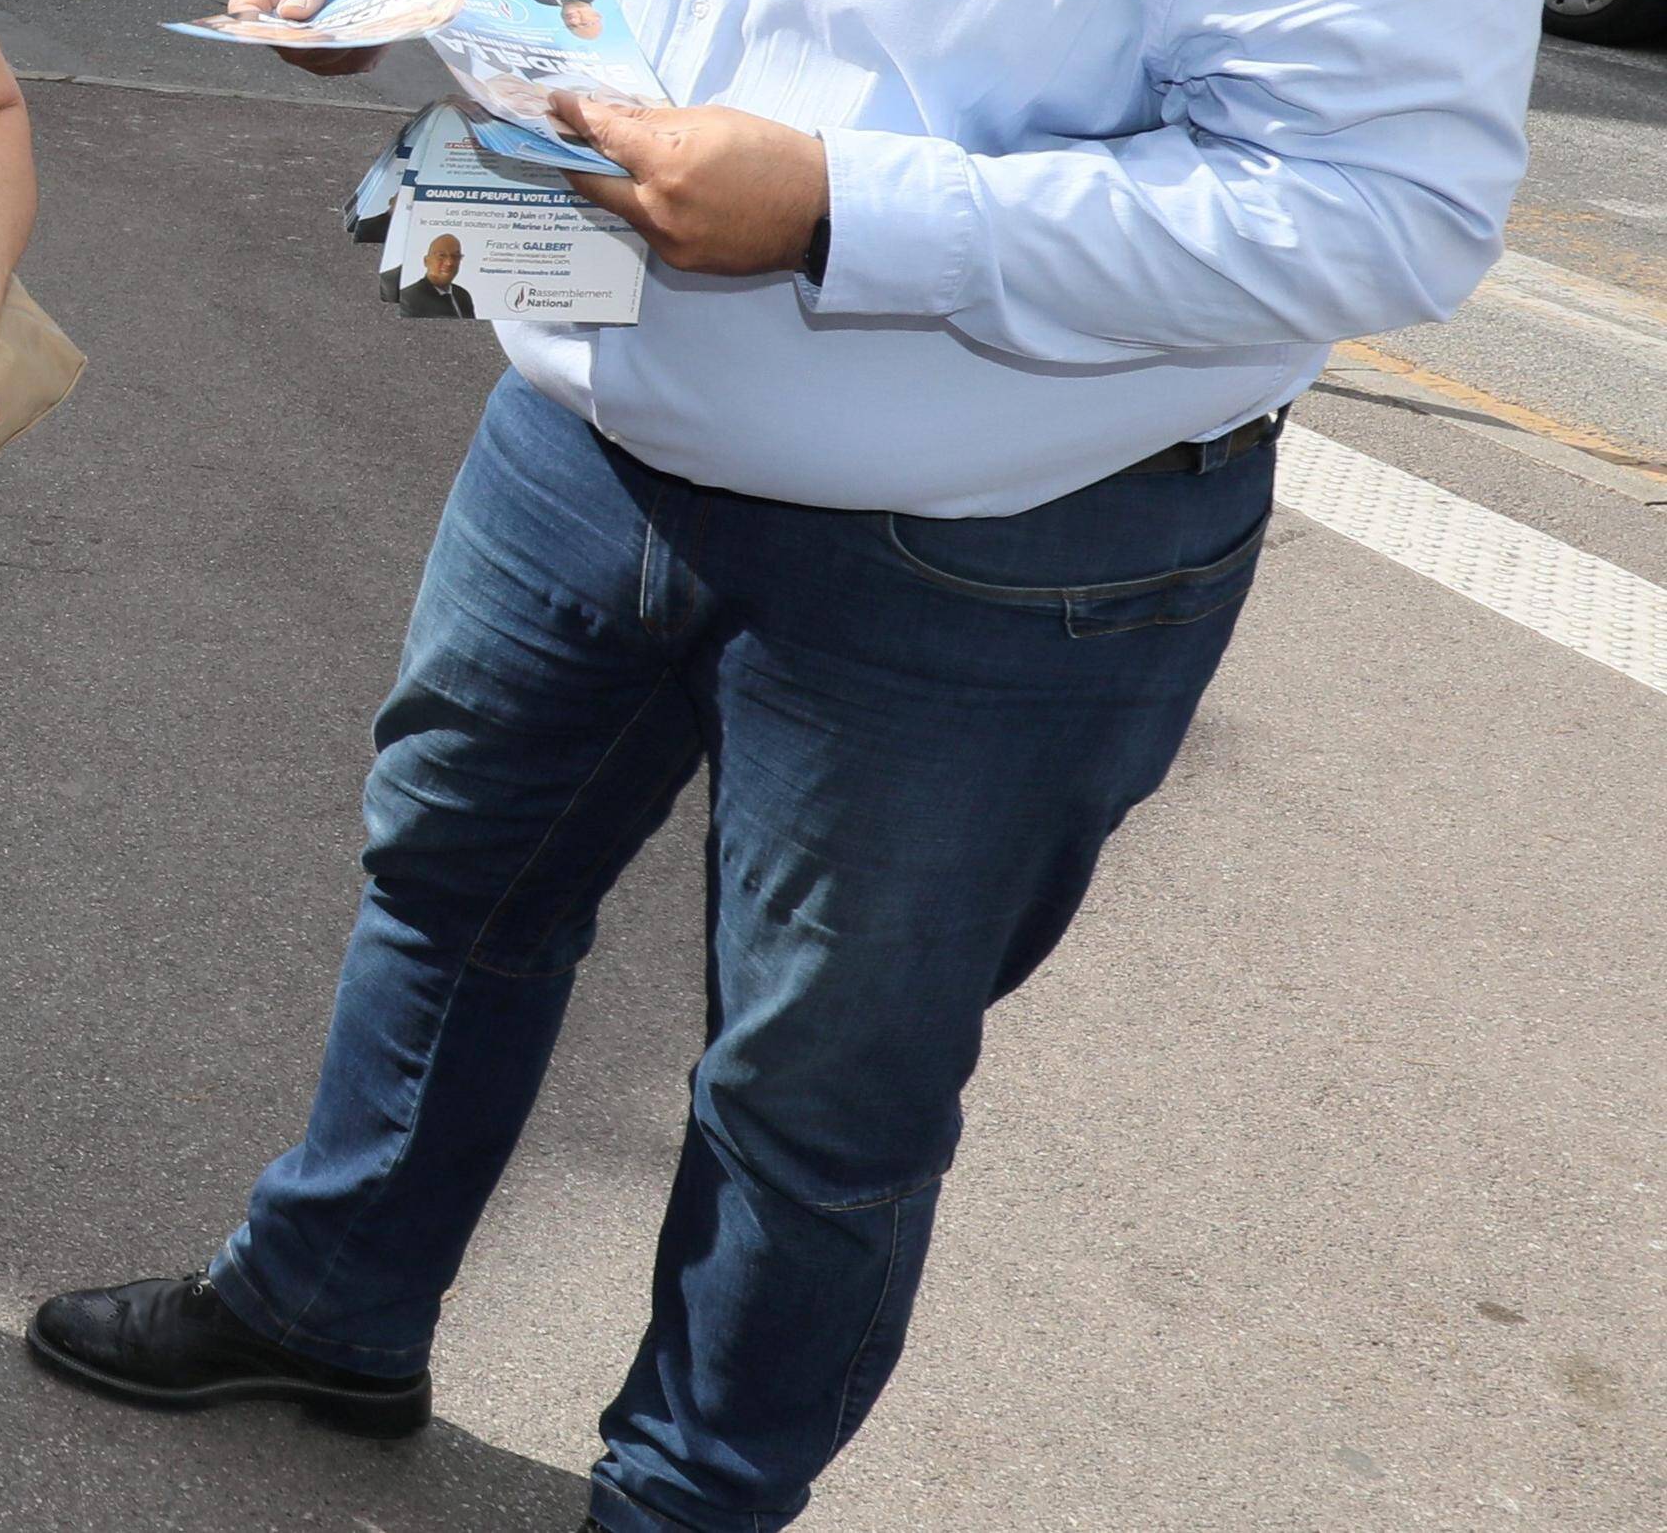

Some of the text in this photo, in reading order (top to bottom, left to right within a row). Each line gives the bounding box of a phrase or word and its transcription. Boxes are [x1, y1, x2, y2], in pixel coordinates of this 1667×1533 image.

[426, 189, 465, 199] QUAND
[466, 191, 479, 199] LE
[480, 192, 520, 202] PEUPLE
[522, 194, 552, 203] VOTE,
[553, 195, 566, 203] LE
[461, 210, 505, 218] dimanches
[520, 212, 536, 220] juin
[428, 219, 462, 227] candidat
[512, 222, 541, 230] Marine
[485, 240, 573, 252] Franck GALBERT
[529, 288, 613, 299] Rassemblement
[528, 298, 574, 308] National
